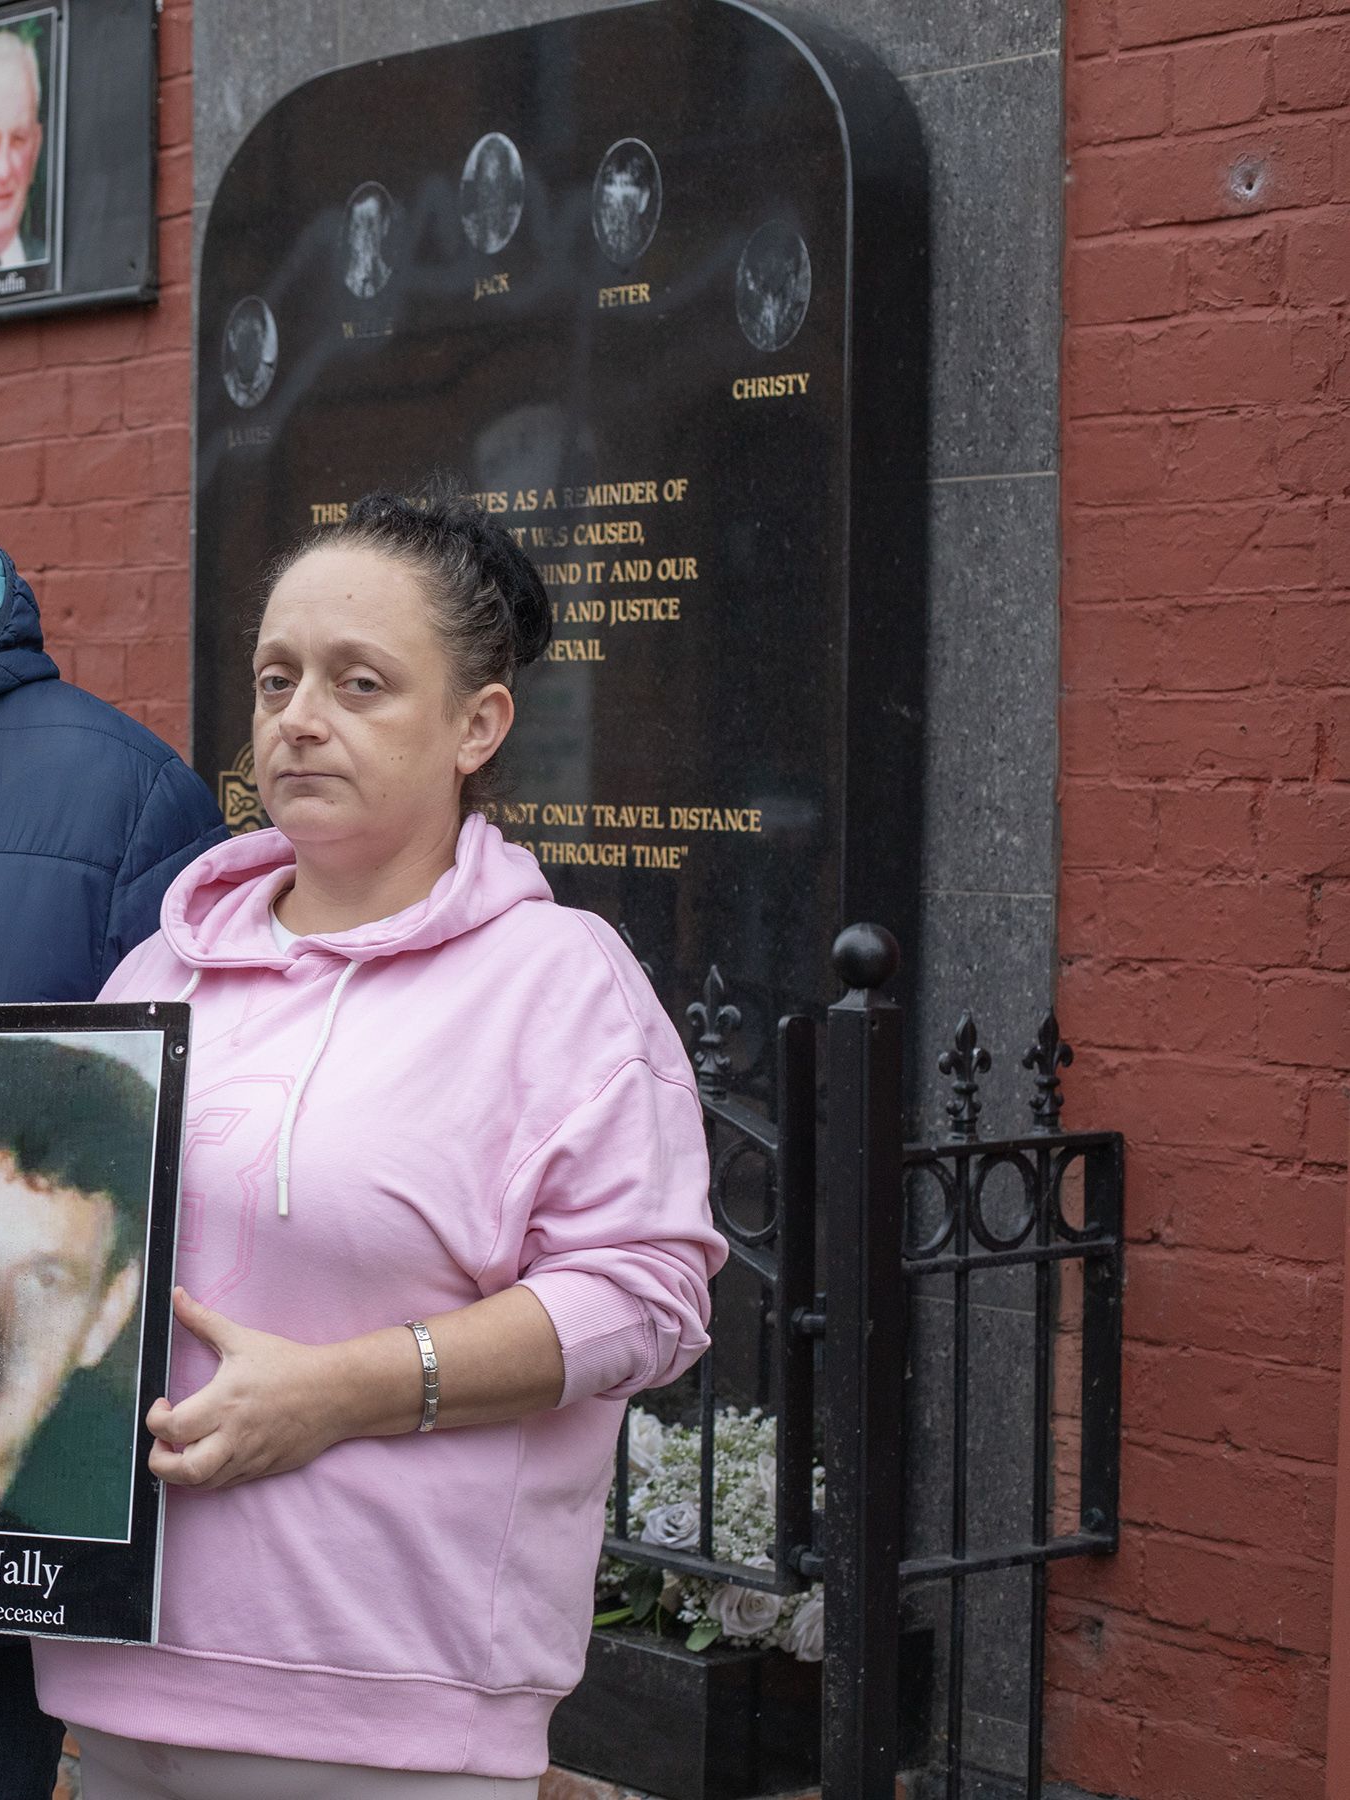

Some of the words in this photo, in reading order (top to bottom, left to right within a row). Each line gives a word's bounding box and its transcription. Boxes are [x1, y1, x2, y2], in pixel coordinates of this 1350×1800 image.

[474, 272, 510, 301] JACK
[598, 283, 651, 308] PETER
[732, 372, 810, 400] CHRISTY
[310, 502, 348, 525] THIS
[513, 489, 538, 512] AS
[543, 488, 557, 510] A
[563, 480, 658, 508] REMINDER
[663, 478, 689, 502] OF
[573, 521, 645, 546] CAUSED,
[586, 561, 605, 584] IT
[609, 560, 653, 583] AND
[657, 557, 698, 581] OUR
[563, 600, 606, 623] AND
[609, 598, 681, 627] JUSTICE
[544, 638, 606, 661] REVAIL
[542, 803, 588, 827] ONLY
[592, 804, 664, 829] TRAVEL
[670, 806, 762, 832] DISTANCE
[539, 841, 627, 867] THROUGH
[631, 845, 688, 869] TIME"
